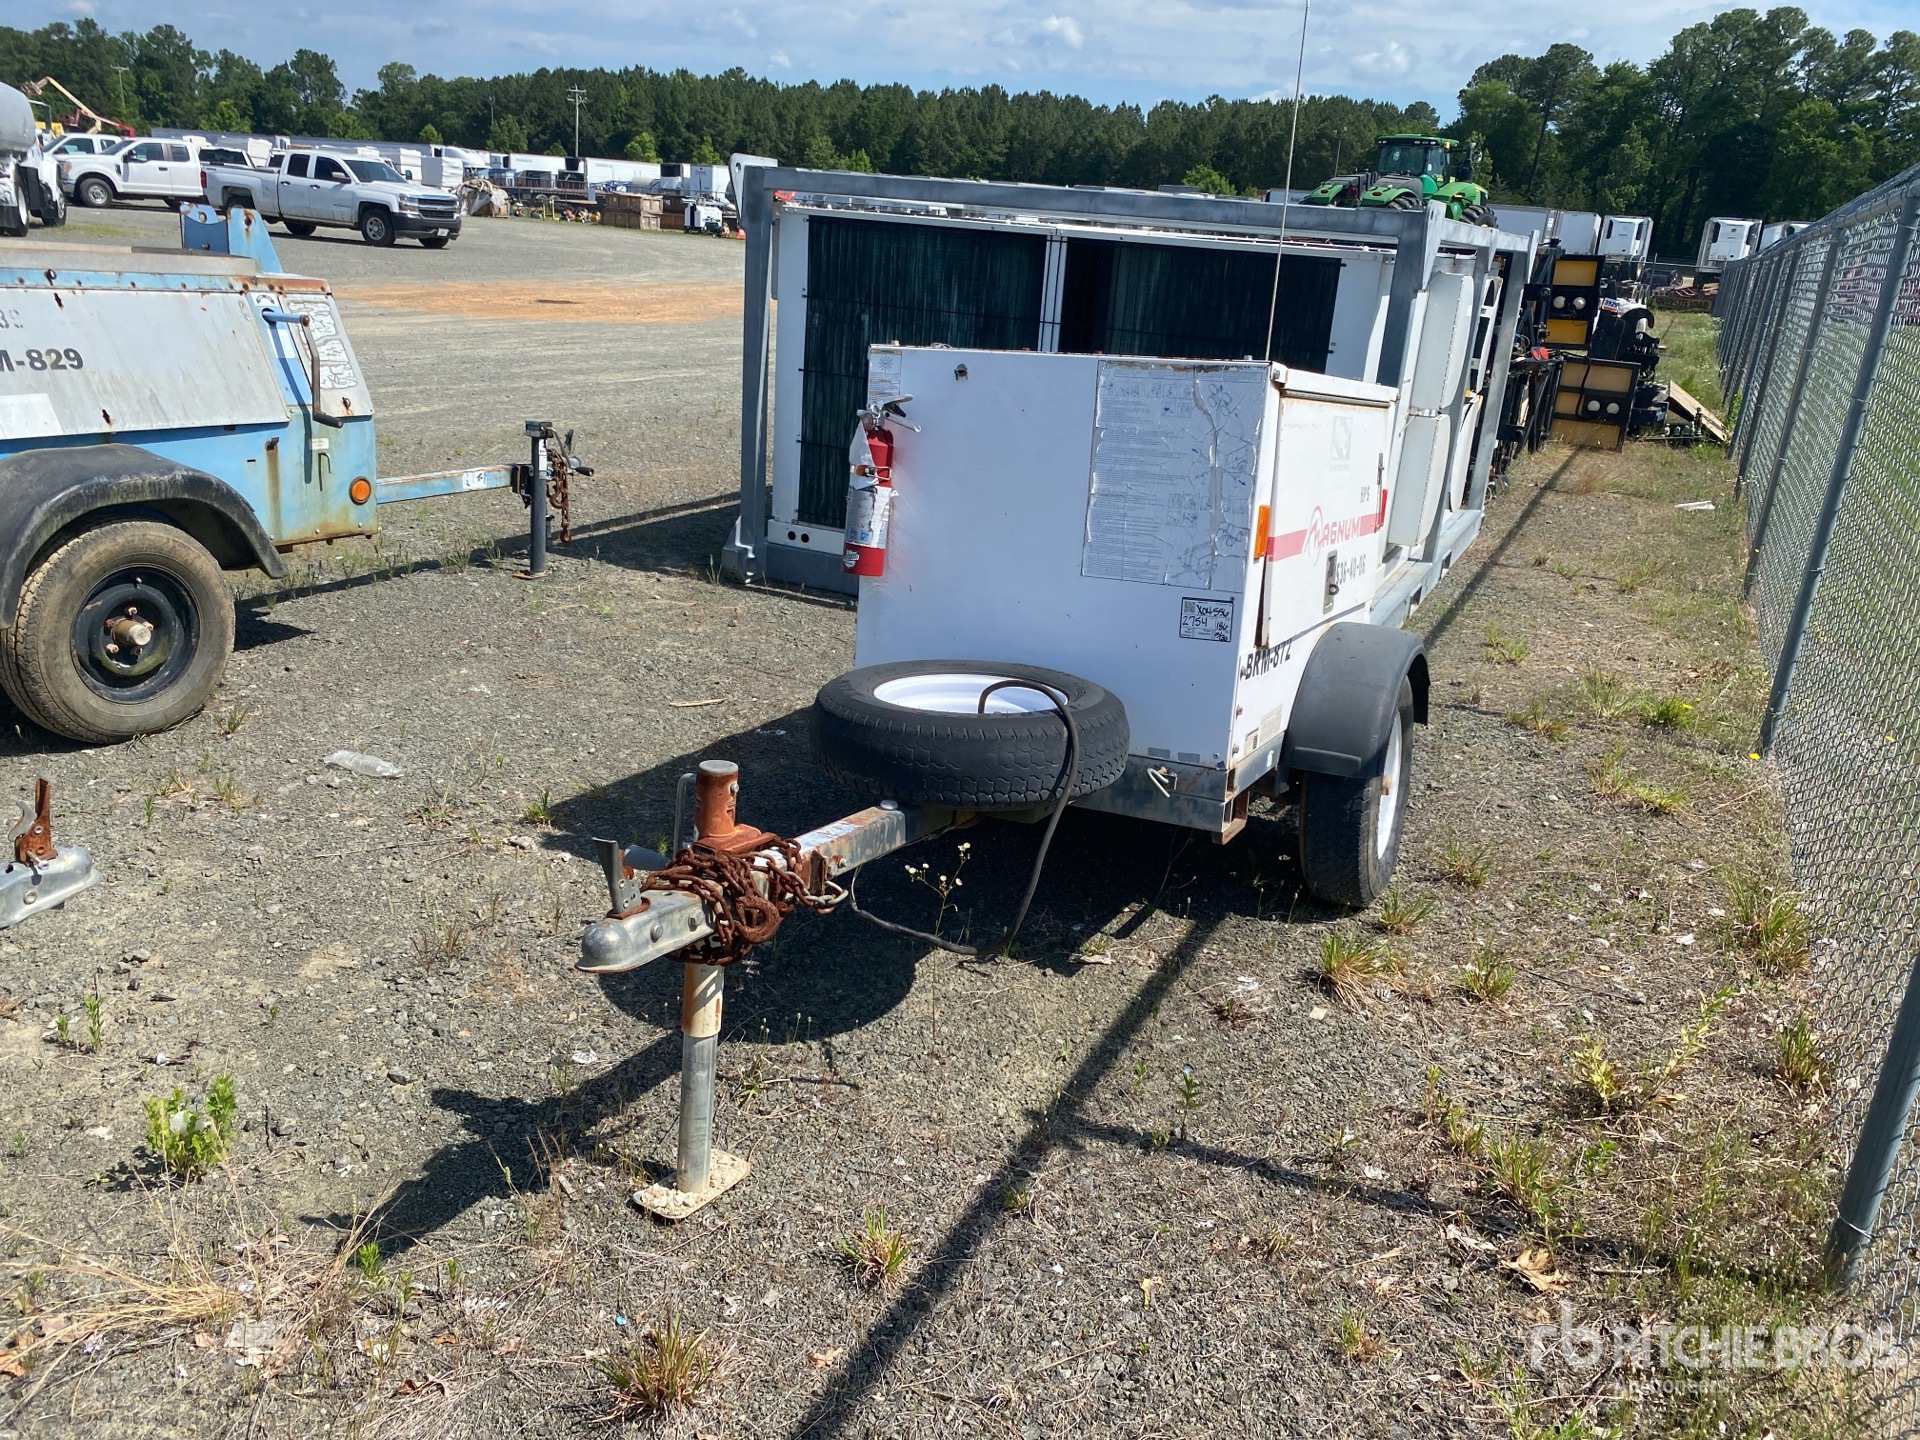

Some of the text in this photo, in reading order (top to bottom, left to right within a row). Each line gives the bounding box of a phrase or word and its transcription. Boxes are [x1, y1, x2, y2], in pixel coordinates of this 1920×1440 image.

[1690, 300, 1708, 310] LOAD
[1303, 507, 1361, 558] MAGNUM
[1182, 615, 1208, 628] 2754
[1245, 638, 1292, 680] BRM-872
